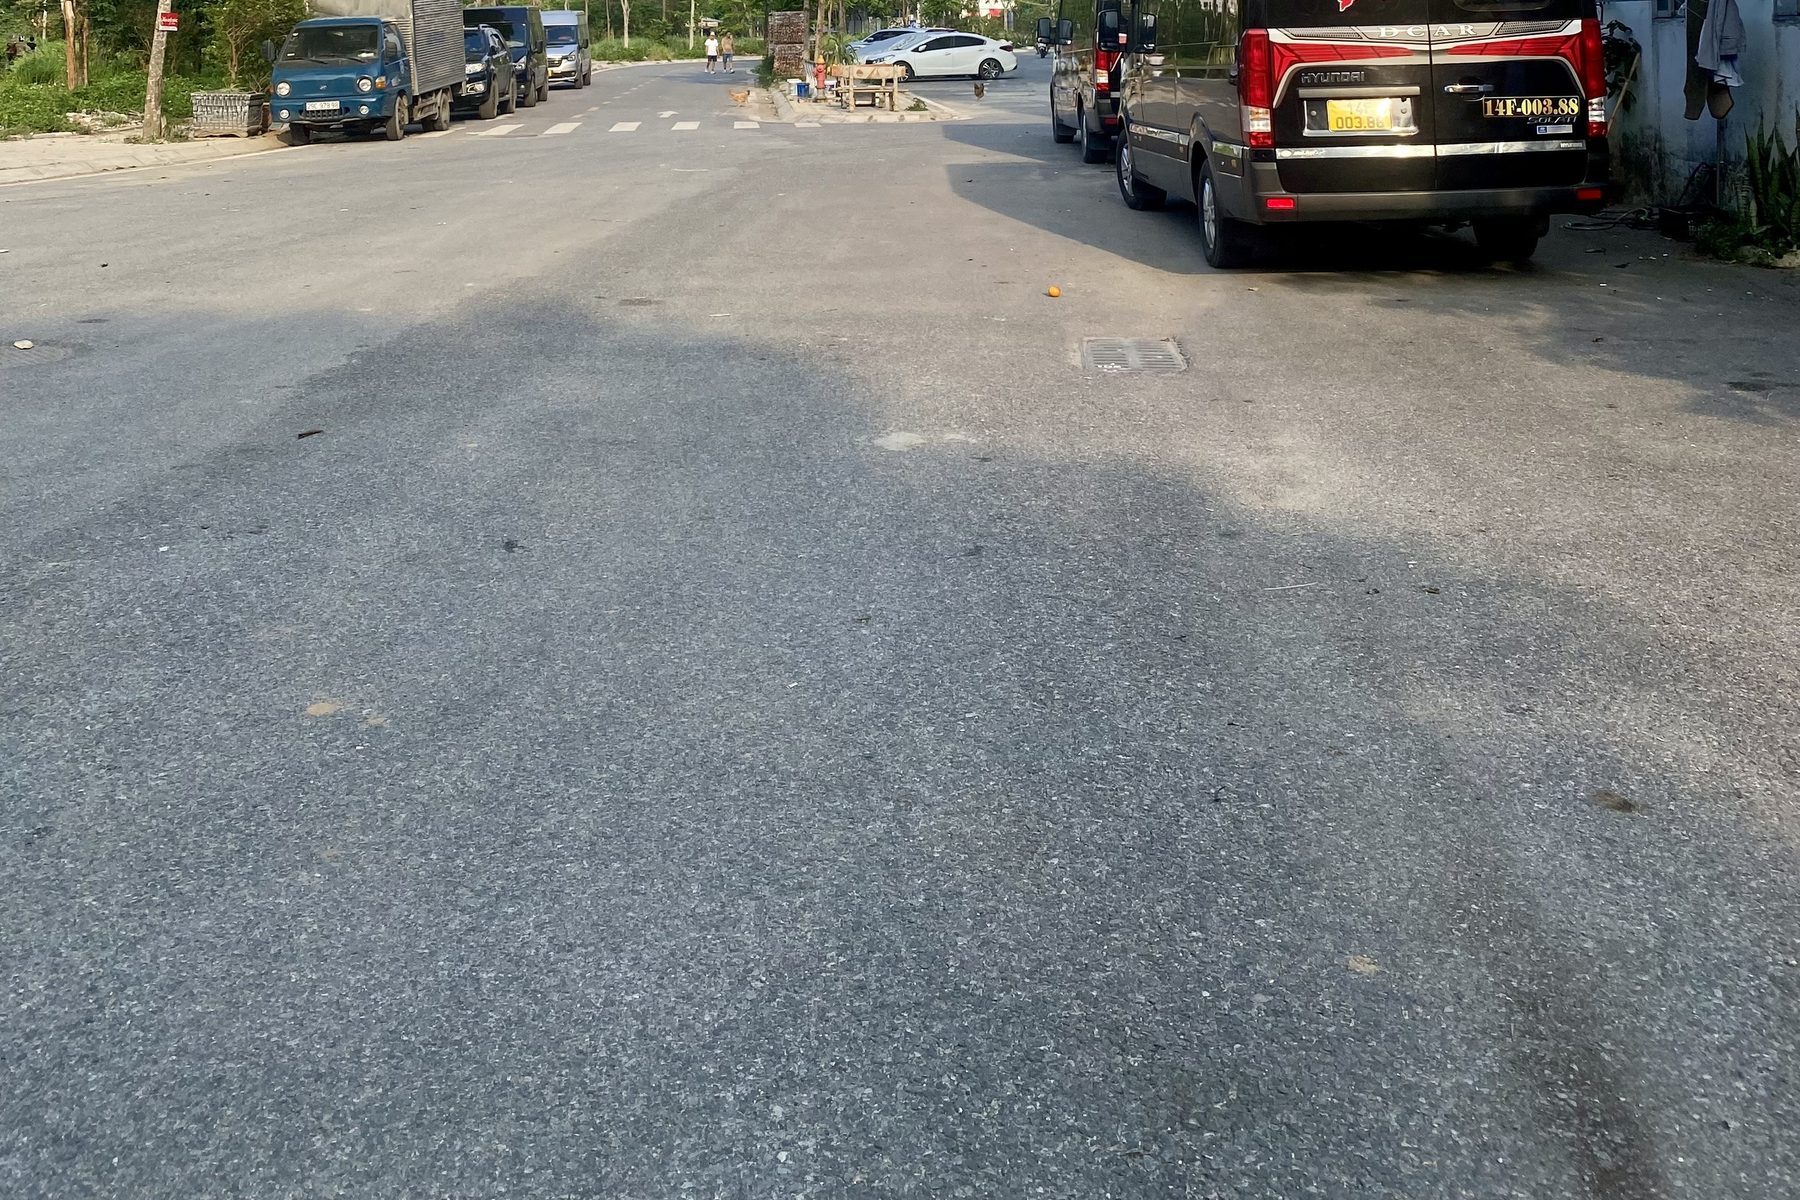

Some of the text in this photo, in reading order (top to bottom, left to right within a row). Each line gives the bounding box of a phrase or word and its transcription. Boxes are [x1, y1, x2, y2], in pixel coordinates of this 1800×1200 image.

[1379, 24, 1477, 38] DCAR
[1301, 71, 1365, 84] HYUNDAI
[1484, 97, 1579, 116] 14F-003.88
